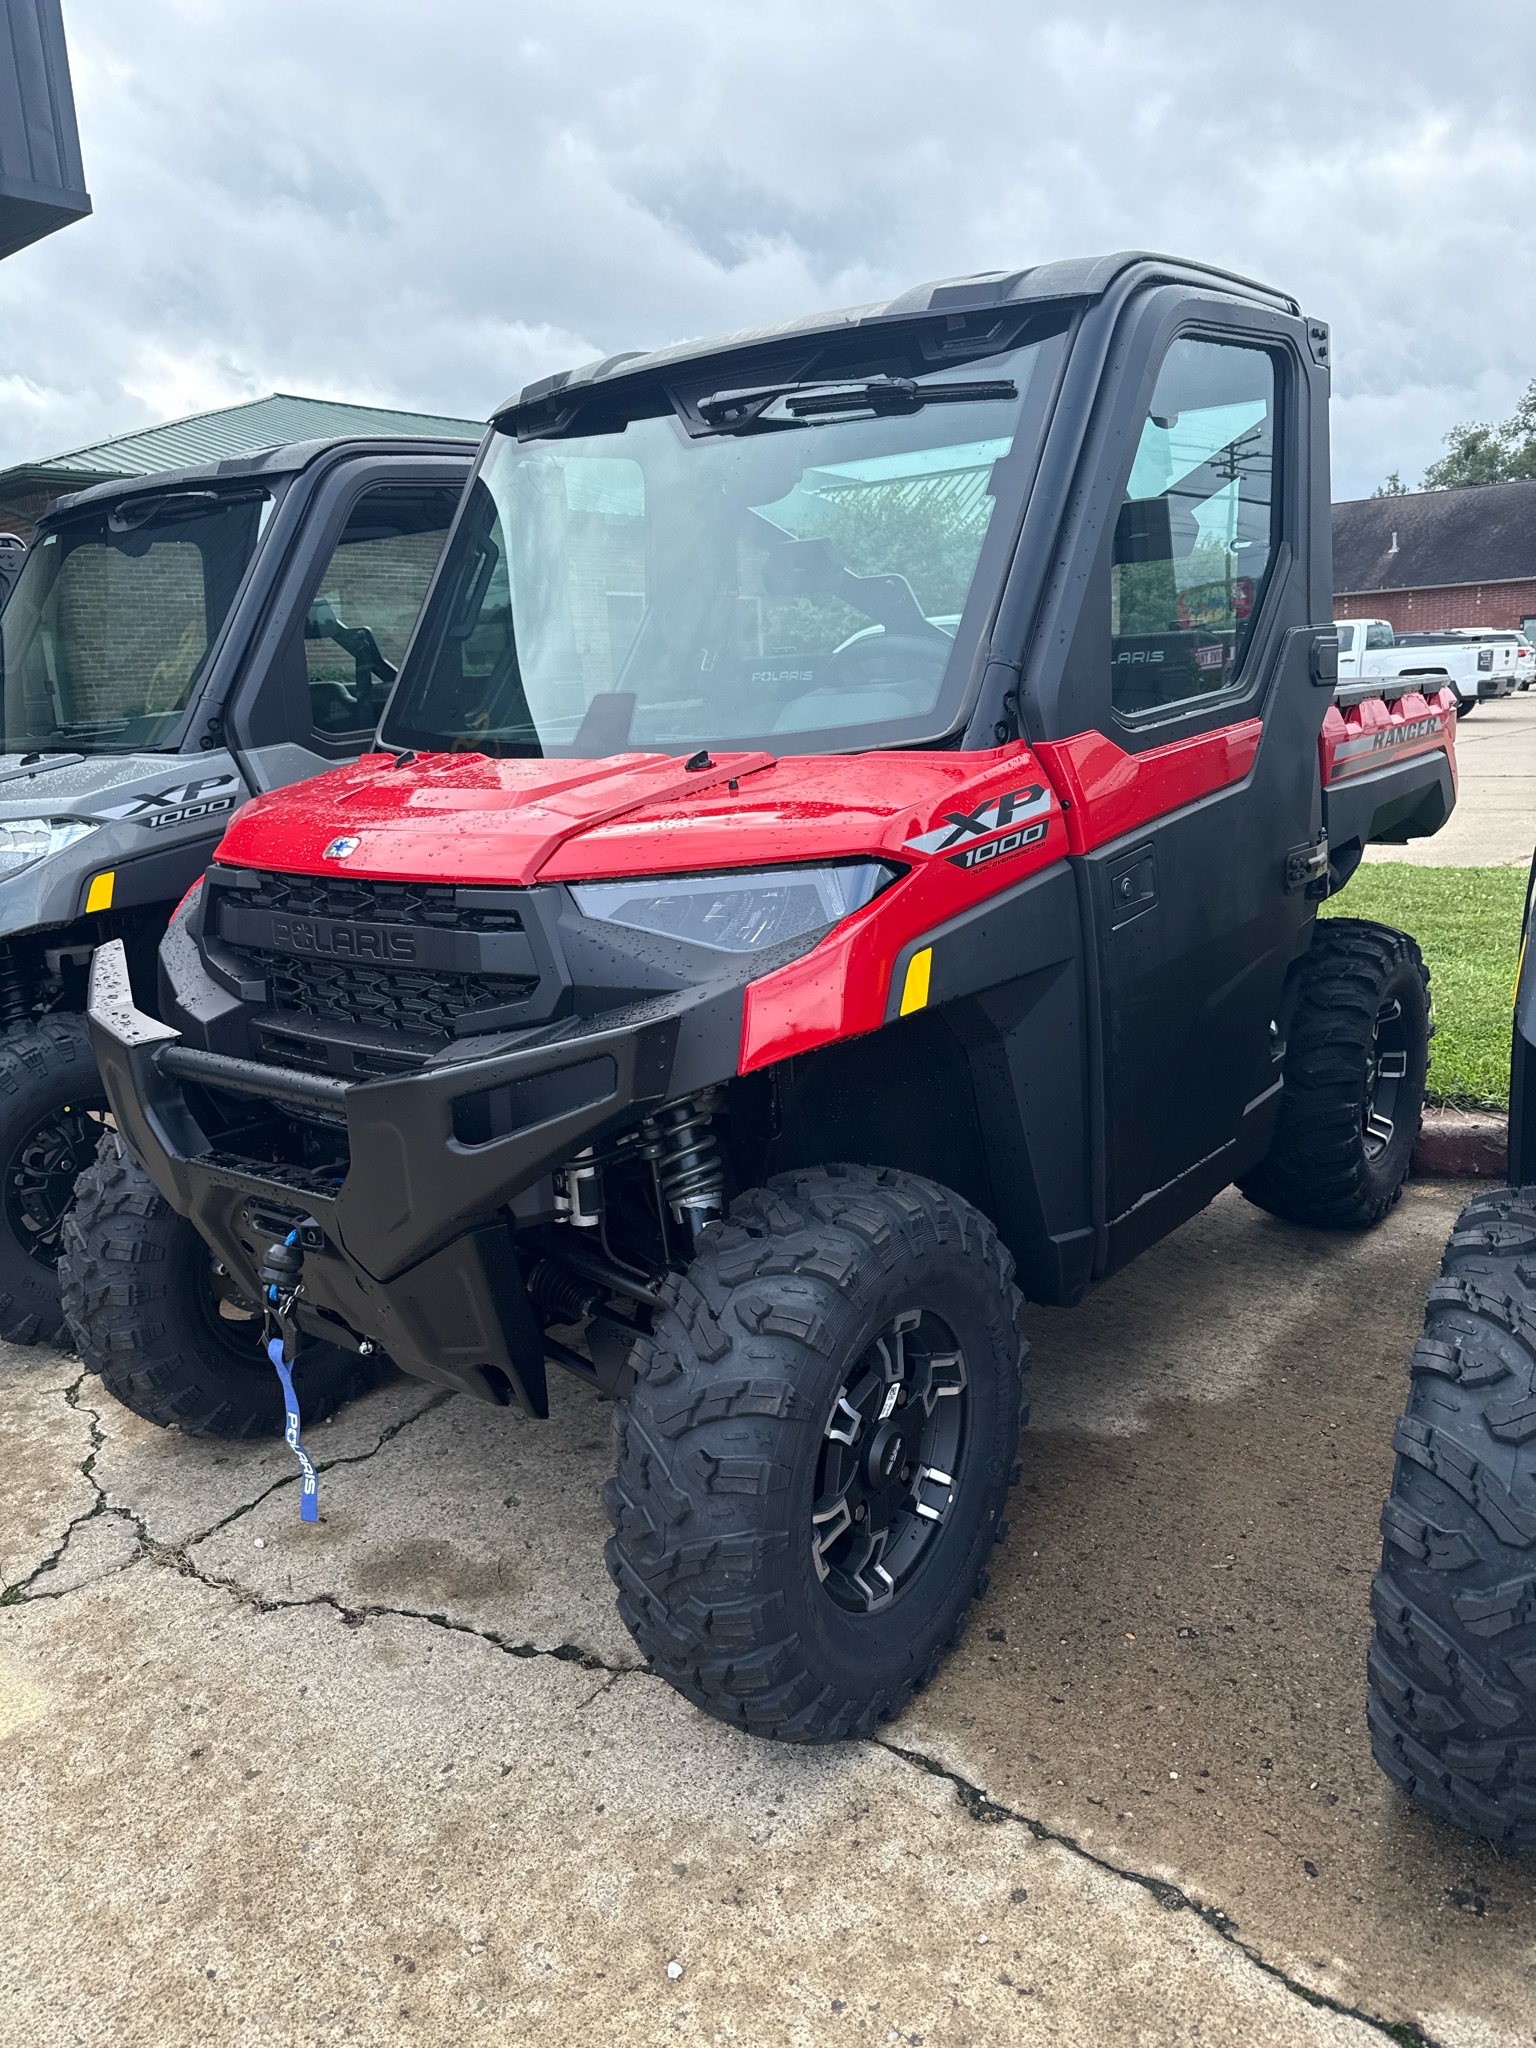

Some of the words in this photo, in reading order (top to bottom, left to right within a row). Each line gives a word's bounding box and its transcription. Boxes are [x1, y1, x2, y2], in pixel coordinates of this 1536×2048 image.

[752, 670, 814, 682] POLARIS
[1372, 716, 1438, 752] RANGER
[121, 773, 235, 818] XP
[150, 798, 231, 828] 1000
[934, 782, 1046, 852] XP
[965, 823, 1044, 868] 1000
[970, 863, 991, 877] DUAL
[991, 847, 1030, 868] OVERHEAD
[1030, 841, 1046, 852] CAM
[271, 917, 417, 962] POLARIS
[286, 1412, 316, 1495] POLARIS
